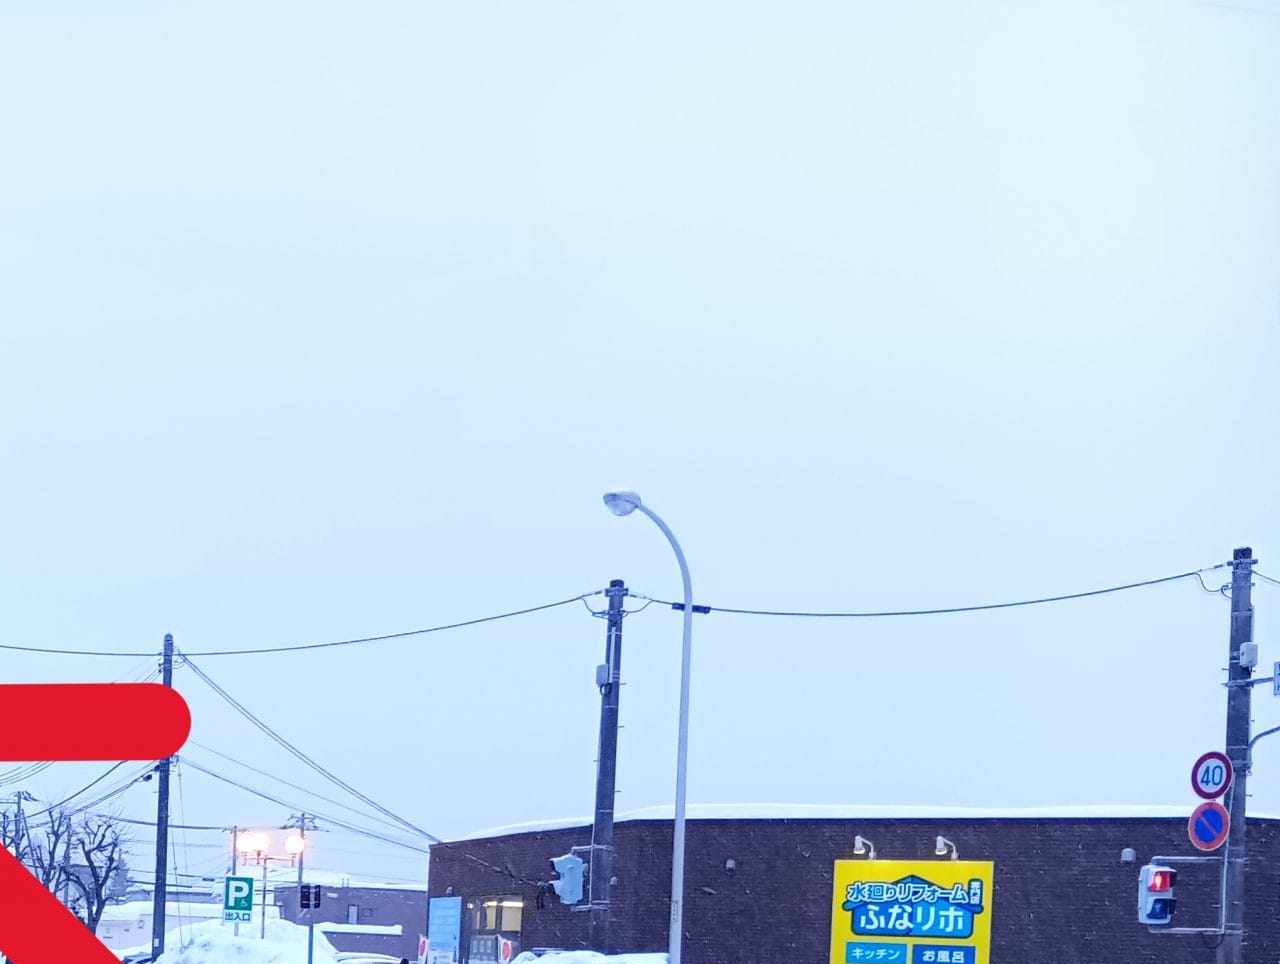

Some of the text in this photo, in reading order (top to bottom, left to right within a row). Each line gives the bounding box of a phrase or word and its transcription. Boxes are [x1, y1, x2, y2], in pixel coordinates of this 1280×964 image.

[1200, 765, 1223, 786] 40
[228, 881, 249, 907] P
[848, 882, 969, 904] 水廻りリフォーム
[225, 912, 251, 921] 出入口
[851, 948, 900, 960] キッチン
[922, 950, 965, 963] お風呂
